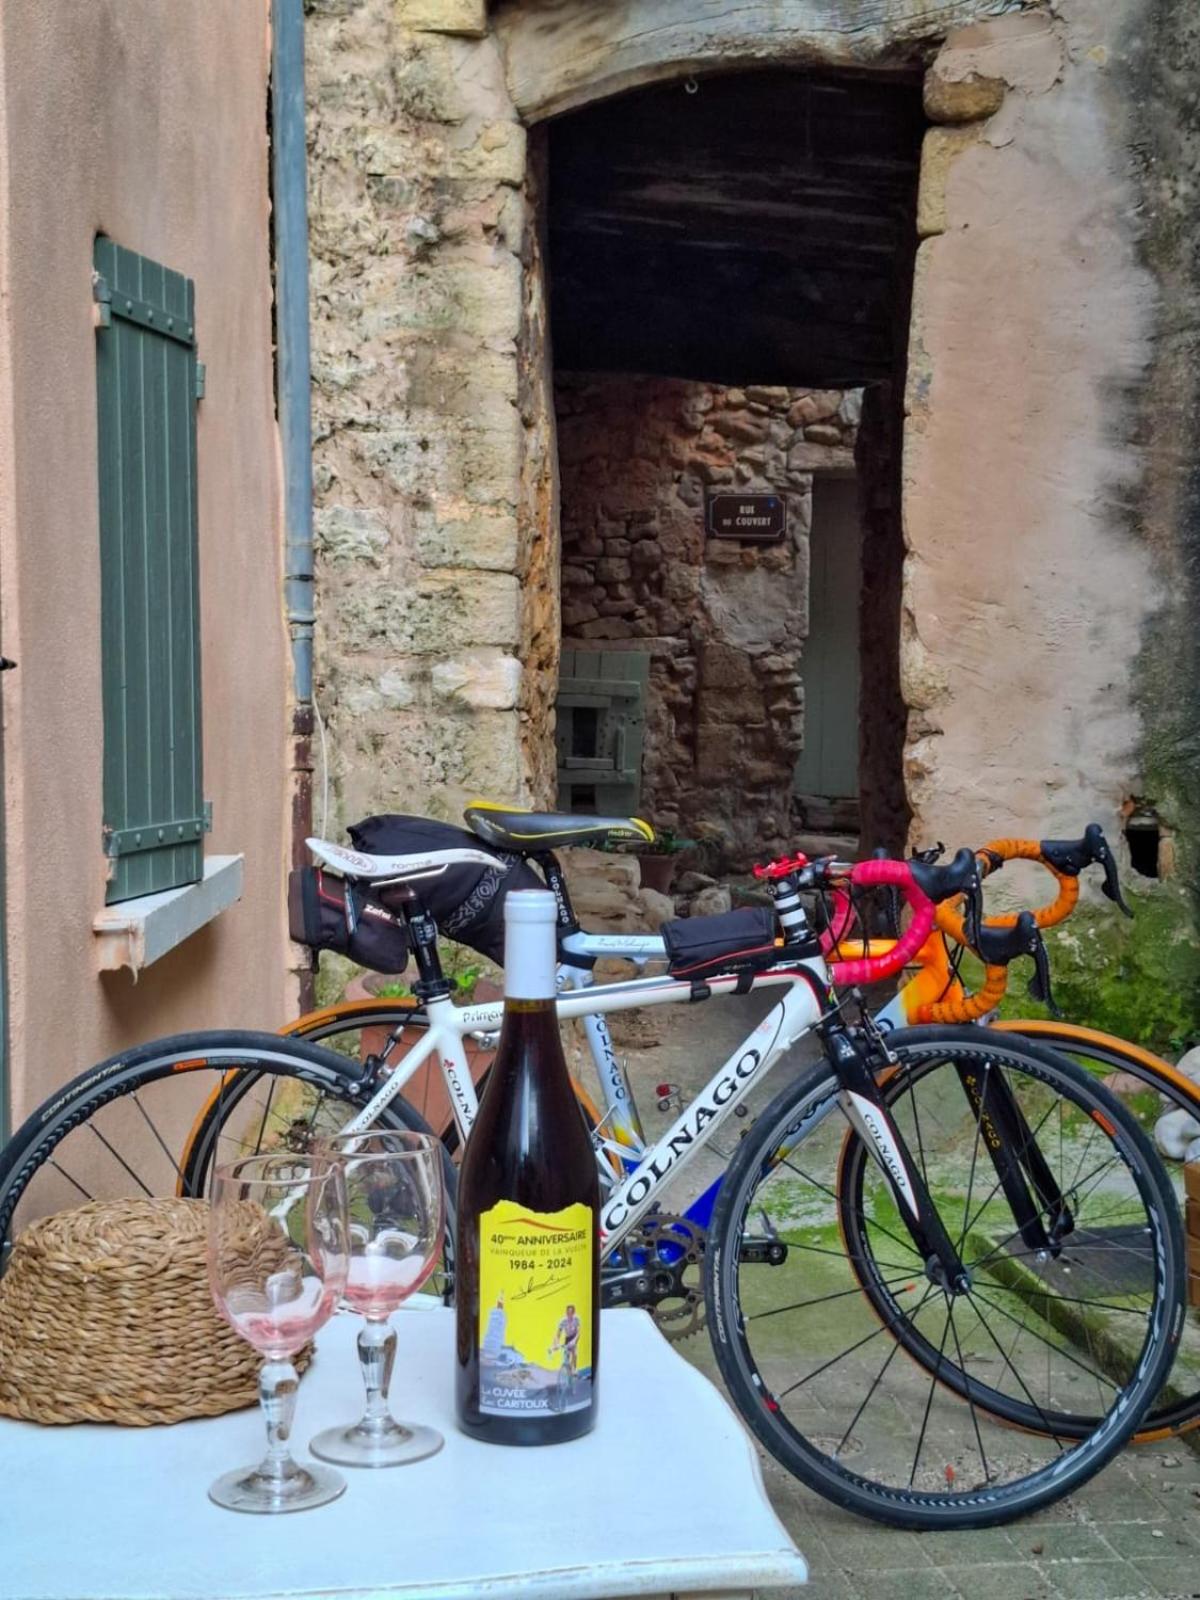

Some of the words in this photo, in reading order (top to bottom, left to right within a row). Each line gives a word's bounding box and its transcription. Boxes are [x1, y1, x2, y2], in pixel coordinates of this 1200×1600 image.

[736, 517, 771, 526] COUVERT
[739, 505, 755, 514] RUE
[550, 876, 570, 924] COLNAGO
[41, 1063, 126, 1121] CONTINENTAL
[970, 1087, 1000, 1148] CONAGO
[605, 1049, 761, 1231] COLNAGO
[864, 1114, 906, 1187] COLNAGO
[517, 1229, 586, 1245] ANNIVERSAIRE
[540, 1248, 550, 1256] DE
[553, 1247, 562, 1256] LA
[510, 1260, 535, 1269] 1984
[547, 1257, 572, 1269] 2024
[713, 1247, 727, 1343] CONTINENTAL
[497, 1398, 549, 1409] CARITOUX
